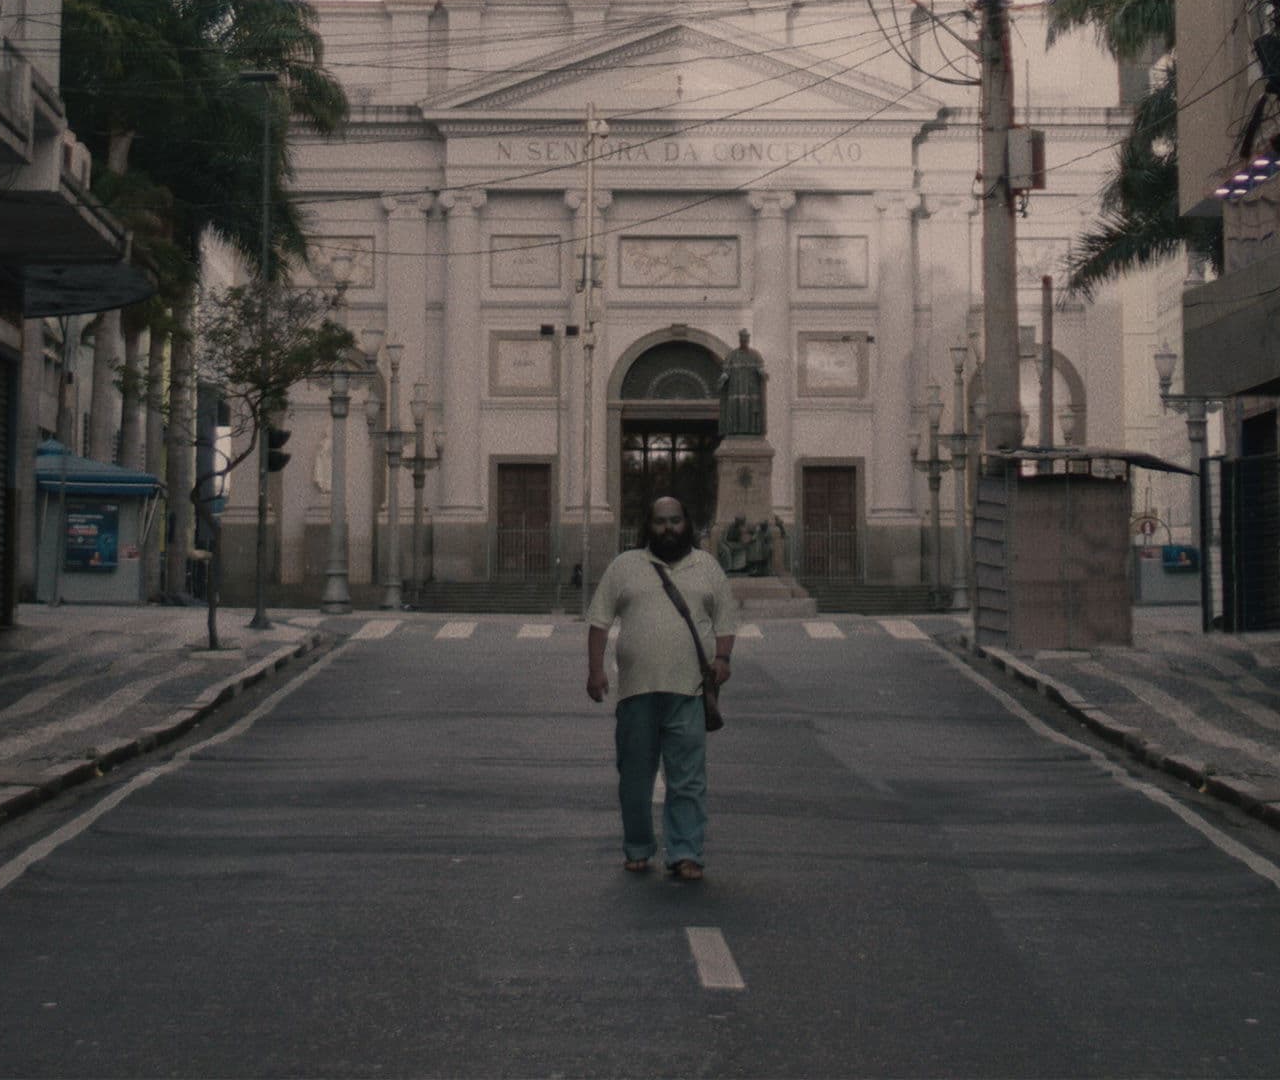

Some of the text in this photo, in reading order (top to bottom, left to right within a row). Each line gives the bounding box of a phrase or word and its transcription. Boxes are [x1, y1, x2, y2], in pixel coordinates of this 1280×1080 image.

[496, 143, 512, 162] N
[664, 143, 697, 163] DA
[714, 139, 863, 164] CONCEIÇÃO
